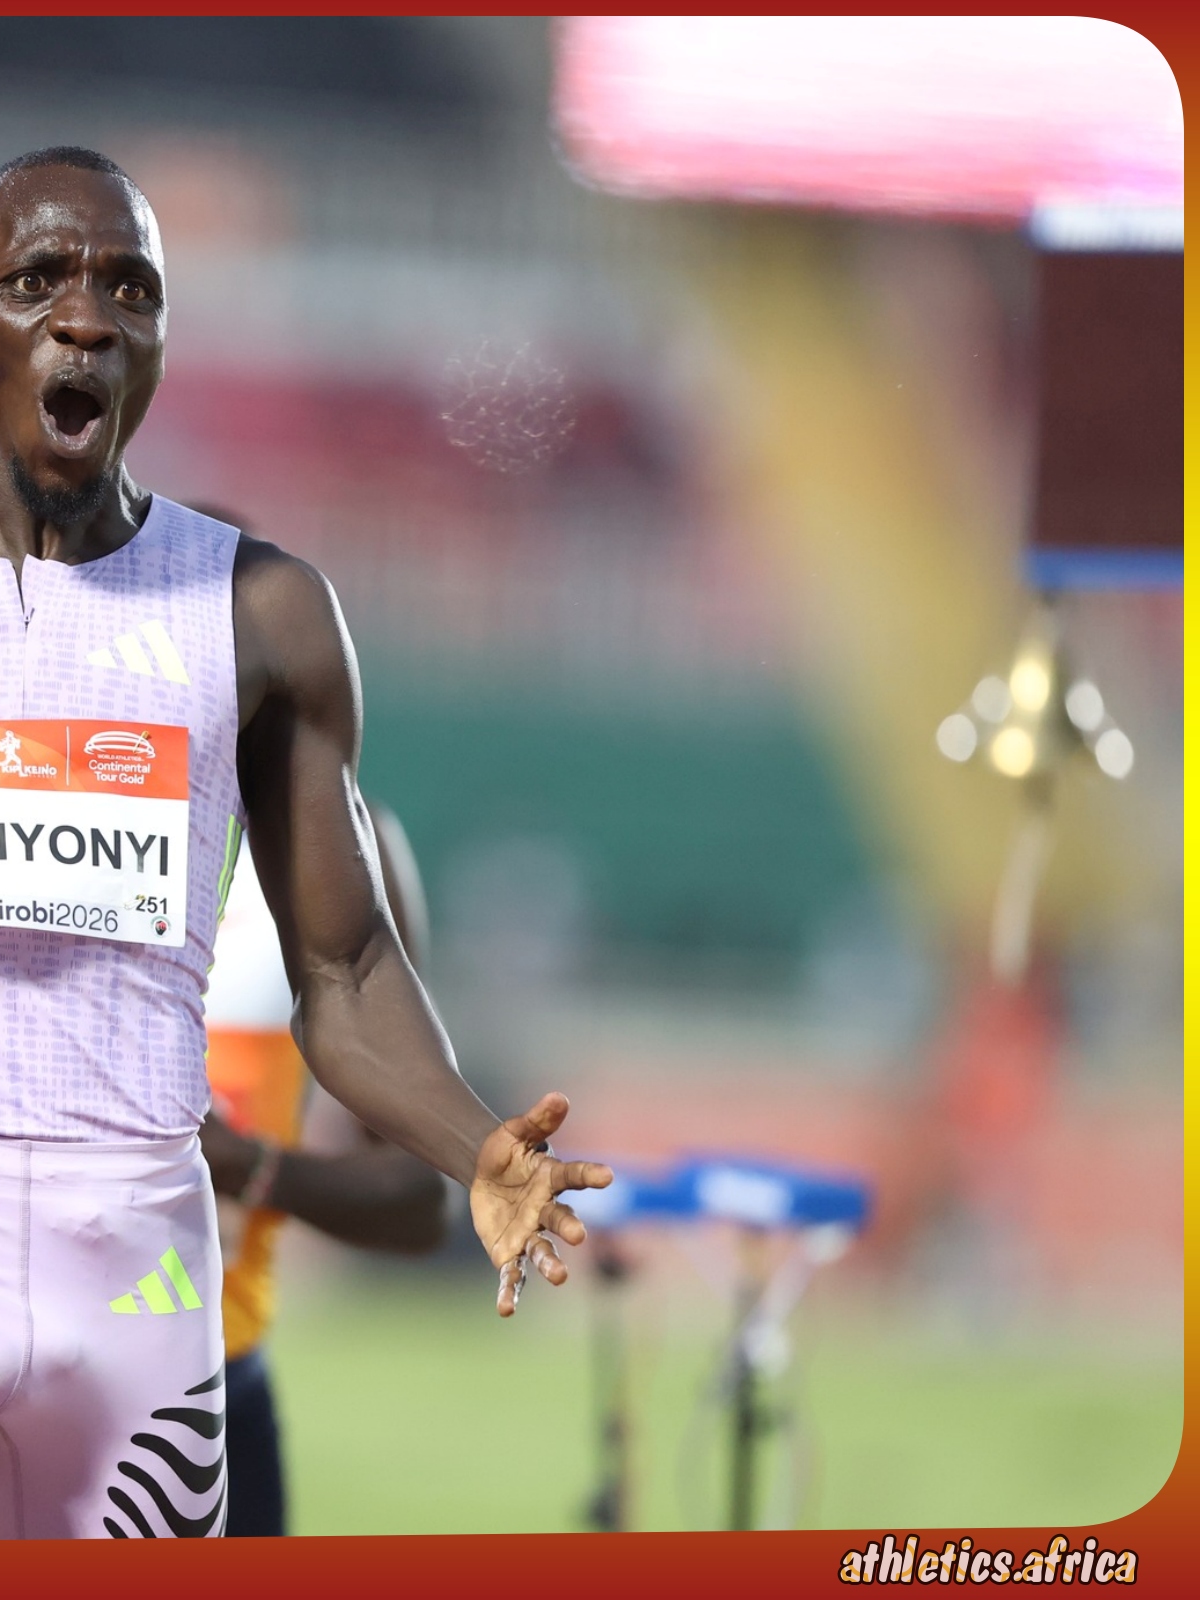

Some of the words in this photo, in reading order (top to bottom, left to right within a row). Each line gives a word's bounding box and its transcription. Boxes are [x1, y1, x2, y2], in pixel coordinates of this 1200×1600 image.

[24, 764, 57, 776] KEINO
[88, 759, 151, 773] Continental
[94, 771, 118, 782] Tour
[119, 773, 145, 785] Gold
[135, 896, 167, 914] 251
